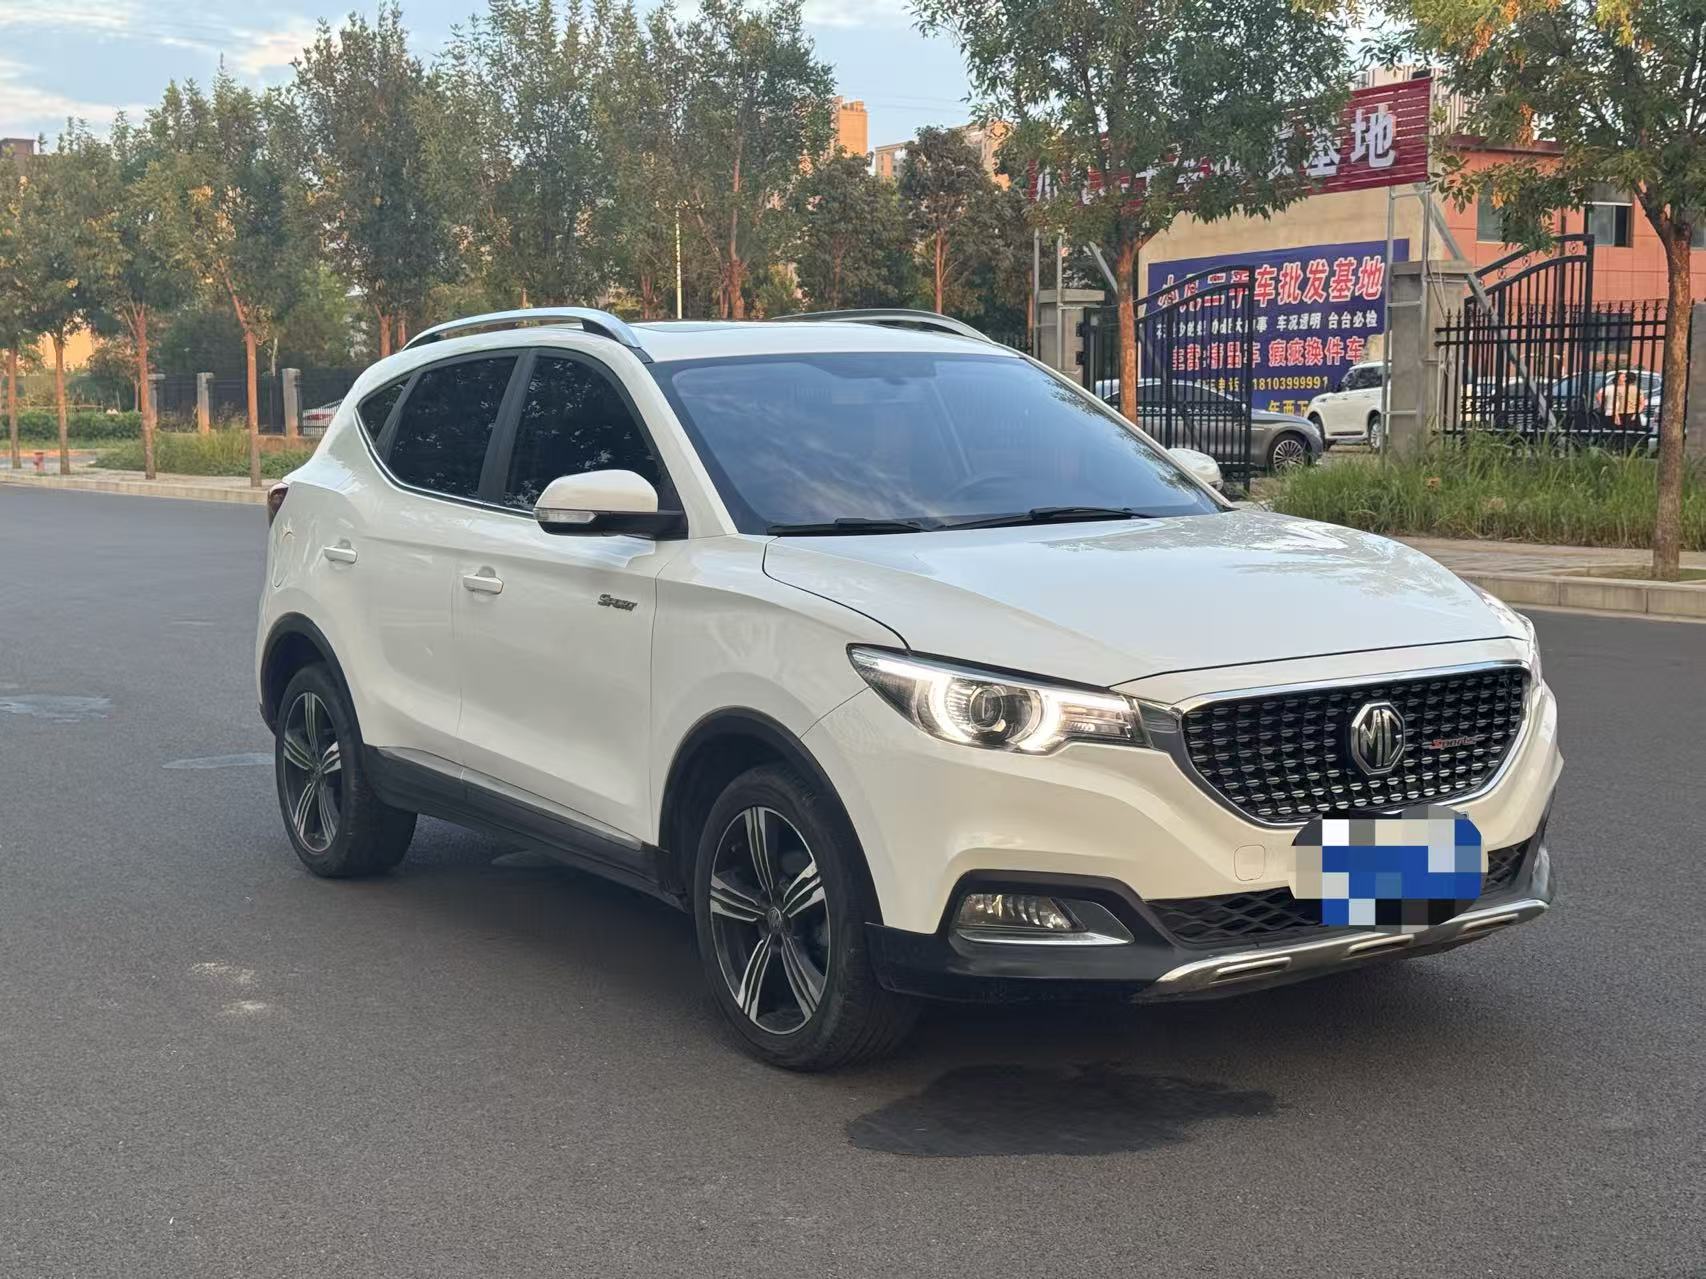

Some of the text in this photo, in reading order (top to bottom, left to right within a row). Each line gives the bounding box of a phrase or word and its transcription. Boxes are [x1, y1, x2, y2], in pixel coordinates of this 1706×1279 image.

[1276, 312, 1322, 332] 车况透明
[1328, 309, 1378, 330] 台台必检
[1359, 708, 1404, 768] MG
